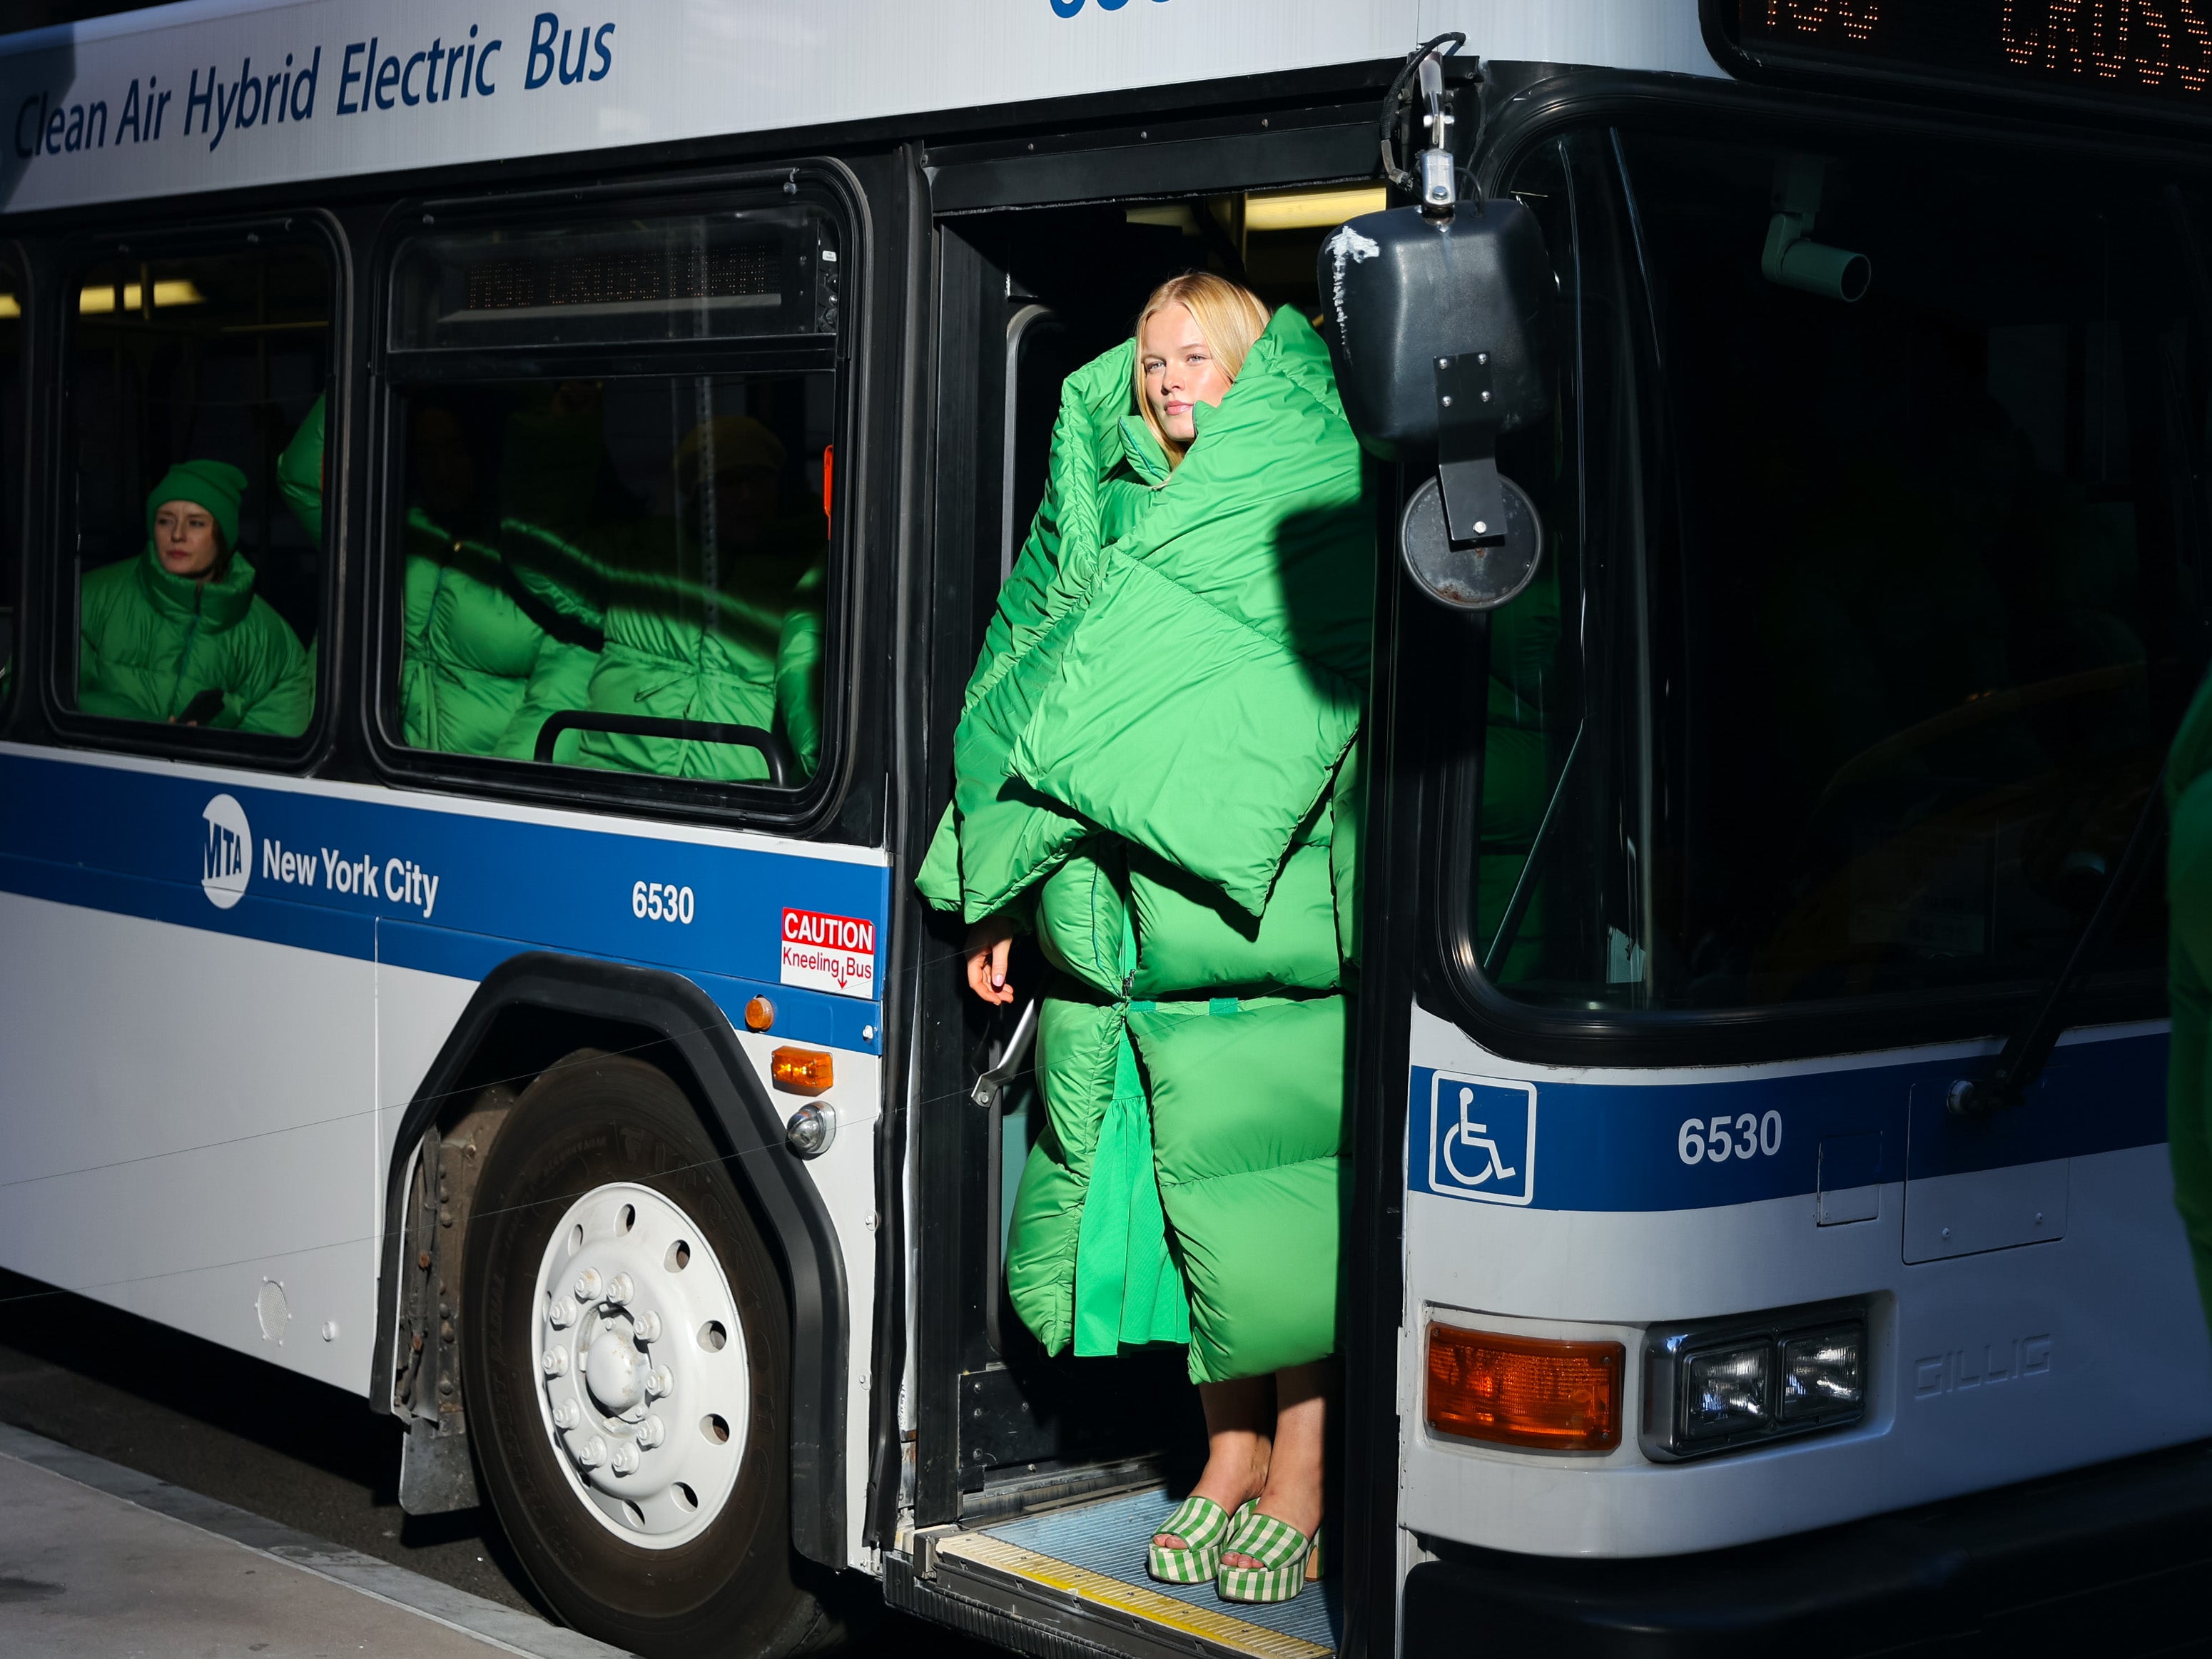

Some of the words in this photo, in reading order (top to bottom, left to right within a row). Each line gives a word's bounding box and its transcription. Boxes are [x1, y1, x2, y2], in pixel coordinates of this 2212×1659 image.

[14, 90, 108, 159] Clean
[115, 78, 171, 146] Air
[183, 46, 321, 151] Hybrid
[335, 24, 502, 116] Electric
[524, 12, 616, 91] Bus
[263, 838, 318, 886] New
[321, 848, 379, 898] York
[384, 857, 440, 918] City
[632, 881, 695, 925] 6530
[783, 912, 873, 952] CAUTION
[783, 946, 840, 979] Kneeling
[846, 956, 873, 980] Bus
[1678, 1110, 1782, 1165] 6530
[1914, 1332, 2051, 1400] GILLIG
